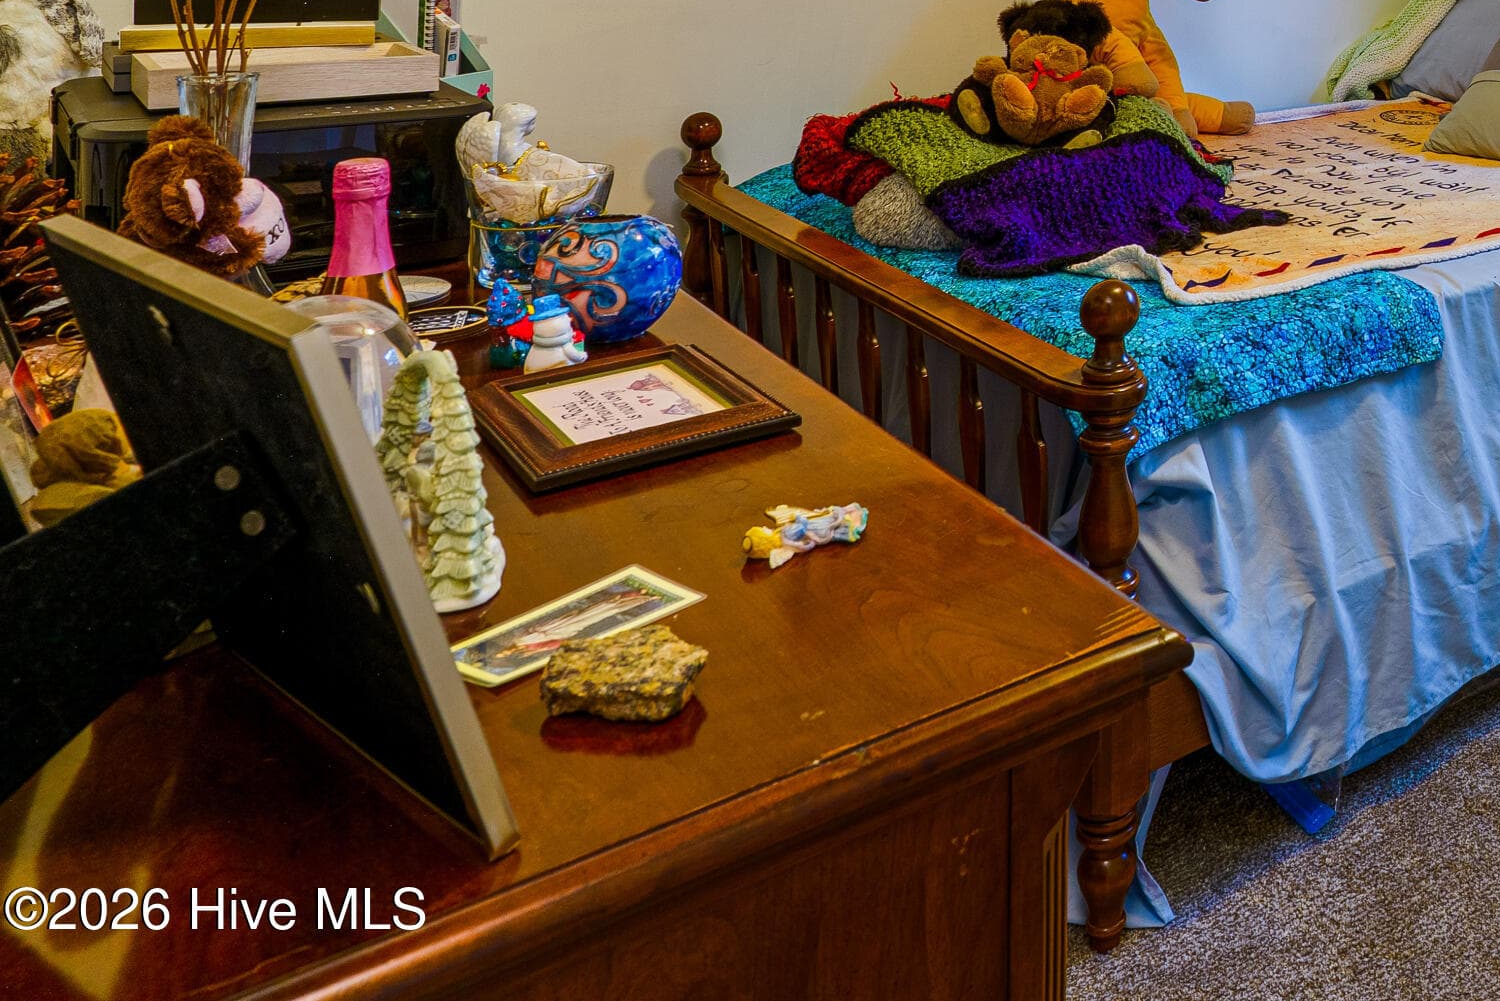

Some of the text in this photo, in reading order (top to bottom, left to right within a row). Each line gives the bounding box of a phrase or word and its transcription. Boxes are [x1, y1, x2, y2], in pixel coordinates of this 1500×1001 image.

[1275, 139, 1319, 152] not
[1419, 177, 1491, 194] want
[1312, 136, 1363, 151] Even
[1363, 149, 1421, 164] when
[1278, 156, 1306, 164] to
[1379, 184, 1437, 200] love
